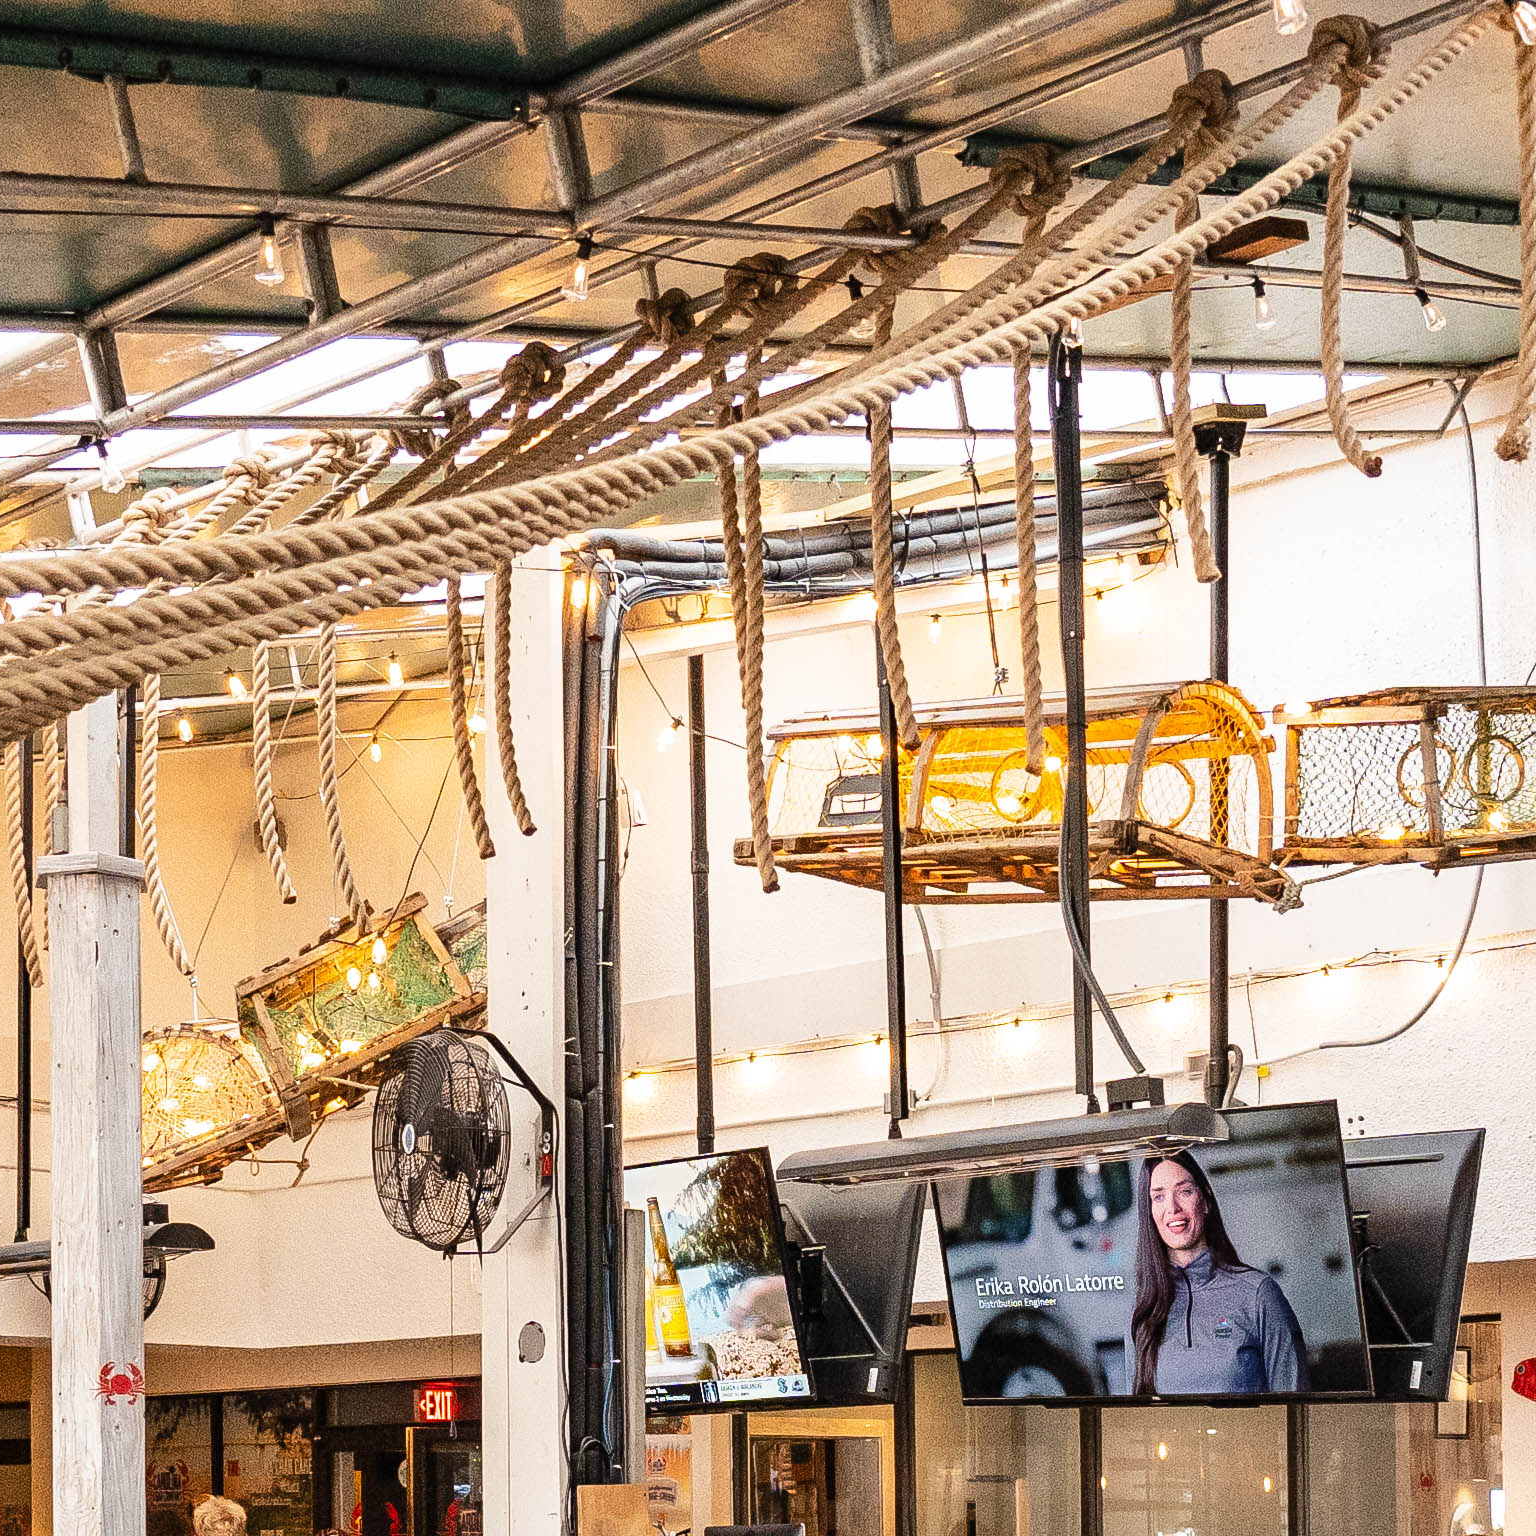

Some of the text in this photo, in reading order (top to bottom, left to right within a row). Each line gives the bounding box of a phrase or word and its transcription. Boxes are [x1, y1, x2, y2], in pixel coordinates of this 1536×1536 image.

[975, 1273, 1125, 1297] Erika Rolón Latorre
[978, 1297, 1057, 1309] Distribution Engineer
[425, 1389, 453, 1421] EXIT
